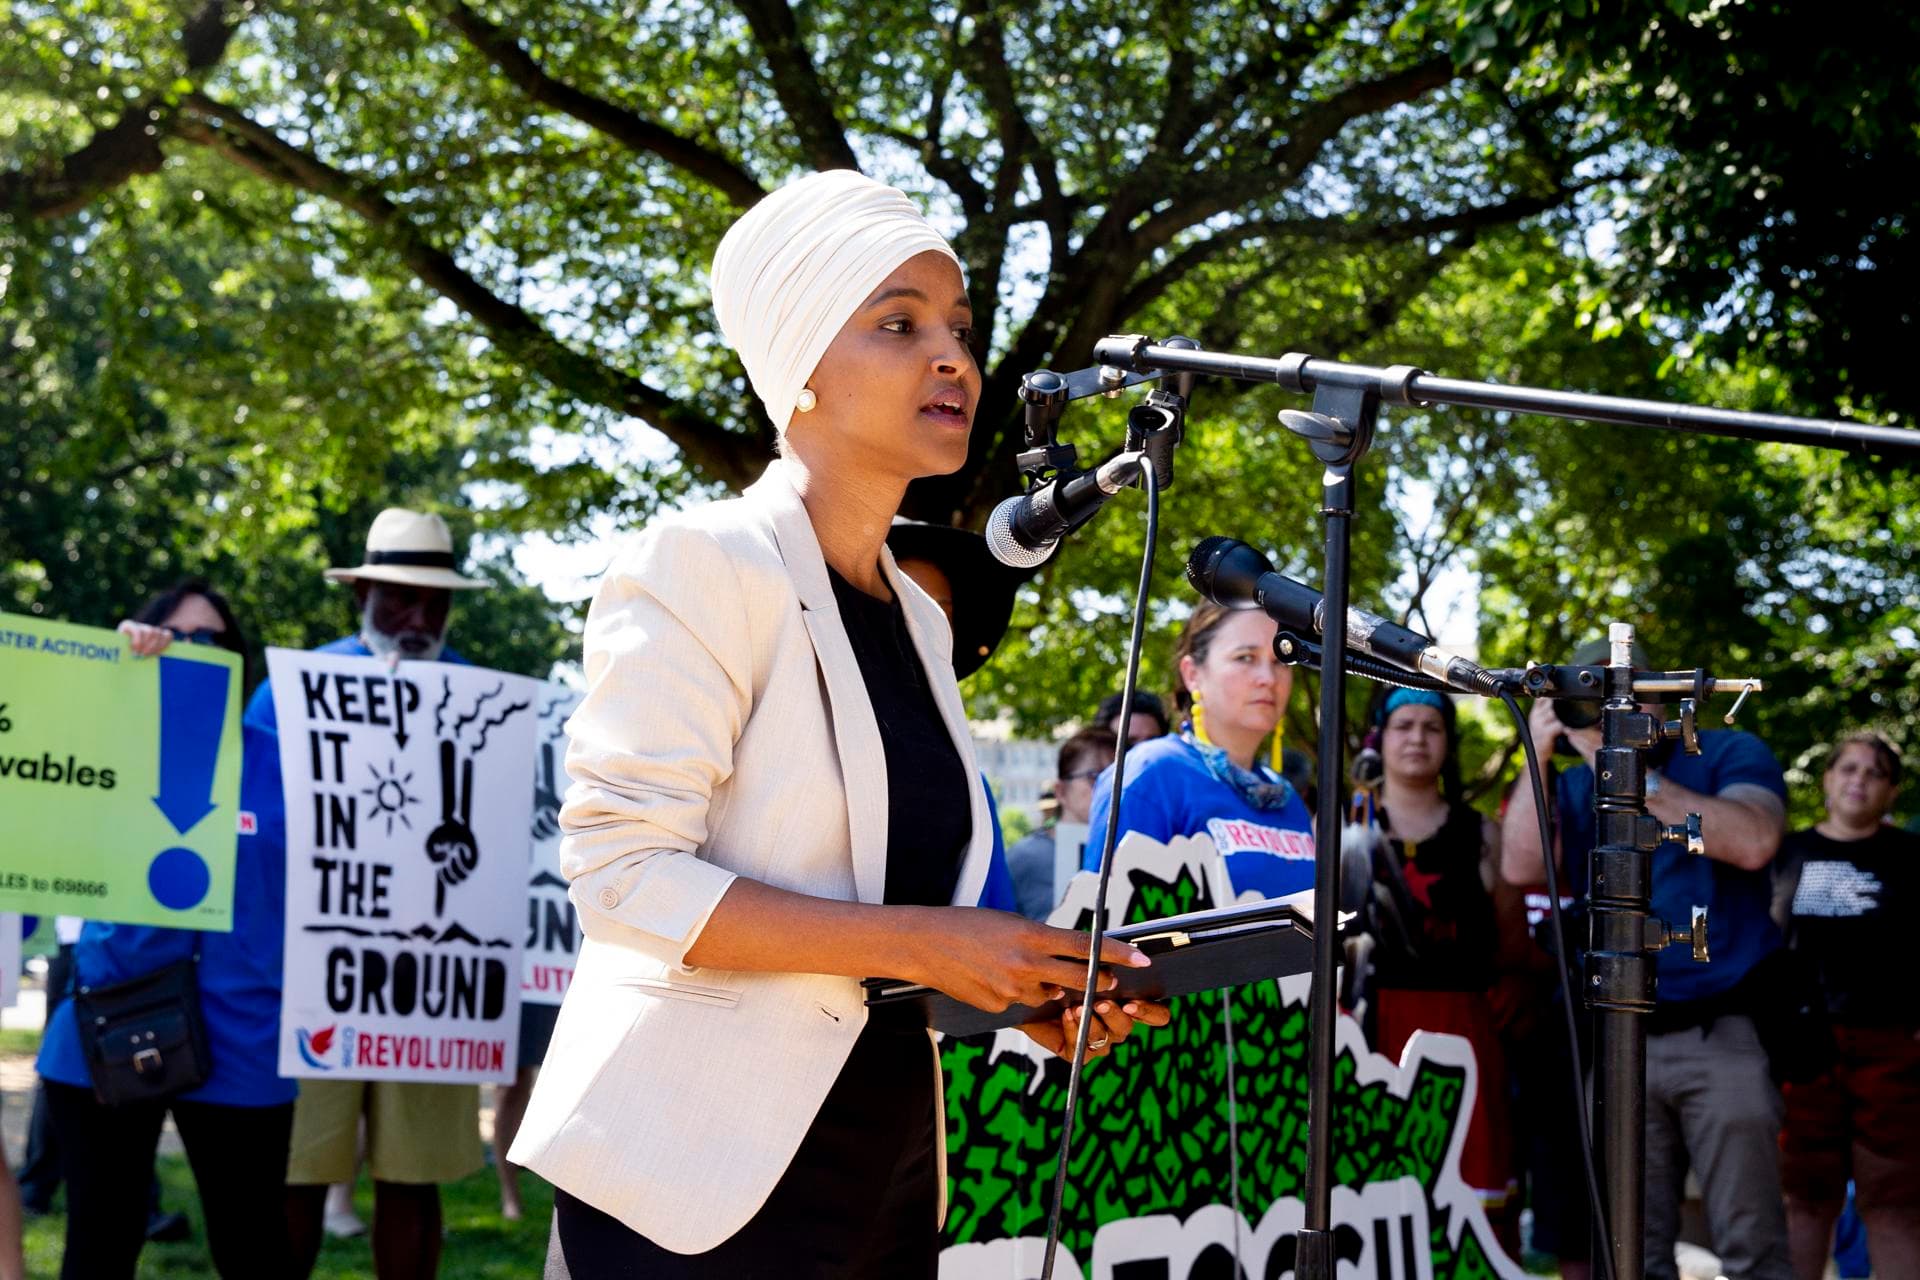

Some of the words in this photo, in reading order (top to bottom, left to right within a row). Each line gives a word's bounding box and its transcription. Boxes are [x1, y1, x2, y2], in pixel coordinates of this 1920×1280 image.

[42, 635, 119, 663] ACTION!
[302, 670, 419, 728] KEEP
[309, 730, 350, 784] IT
[314, 792, 357, 851] IN
[32, 877, 49, 893] to
[313, 857, 393, 918] THE
[327, 946, 507, 1021] GROUND
[357, 1031, 505, 1073] REVOLUTION
